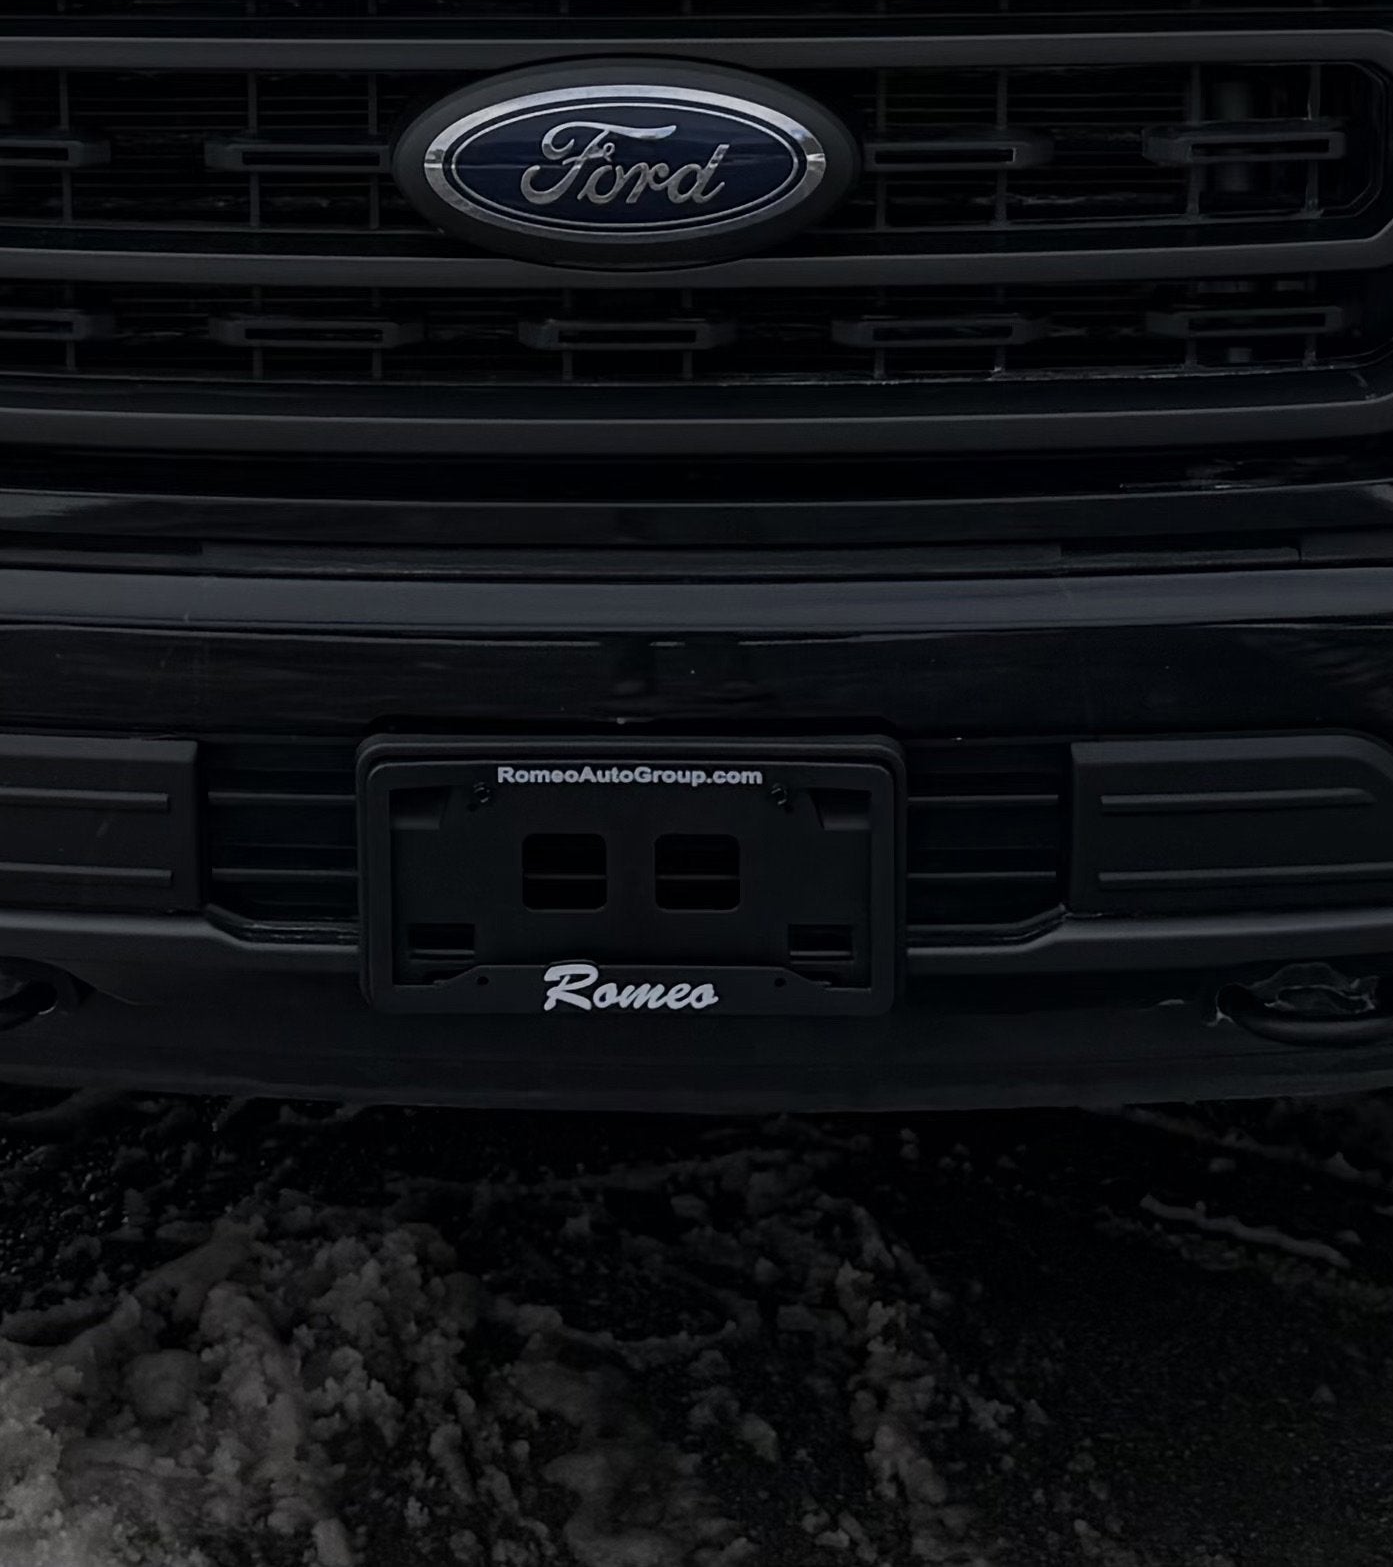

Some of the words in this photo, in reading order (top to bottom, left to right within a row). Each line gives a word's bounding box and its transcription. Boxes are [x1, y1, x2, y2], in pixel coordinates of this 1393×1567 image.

[520, 121, 730, 205] Ford
[497, 765, 763, 786] RomeoAutoGroup.com
[543, 963, 719, 1011] Romeo
